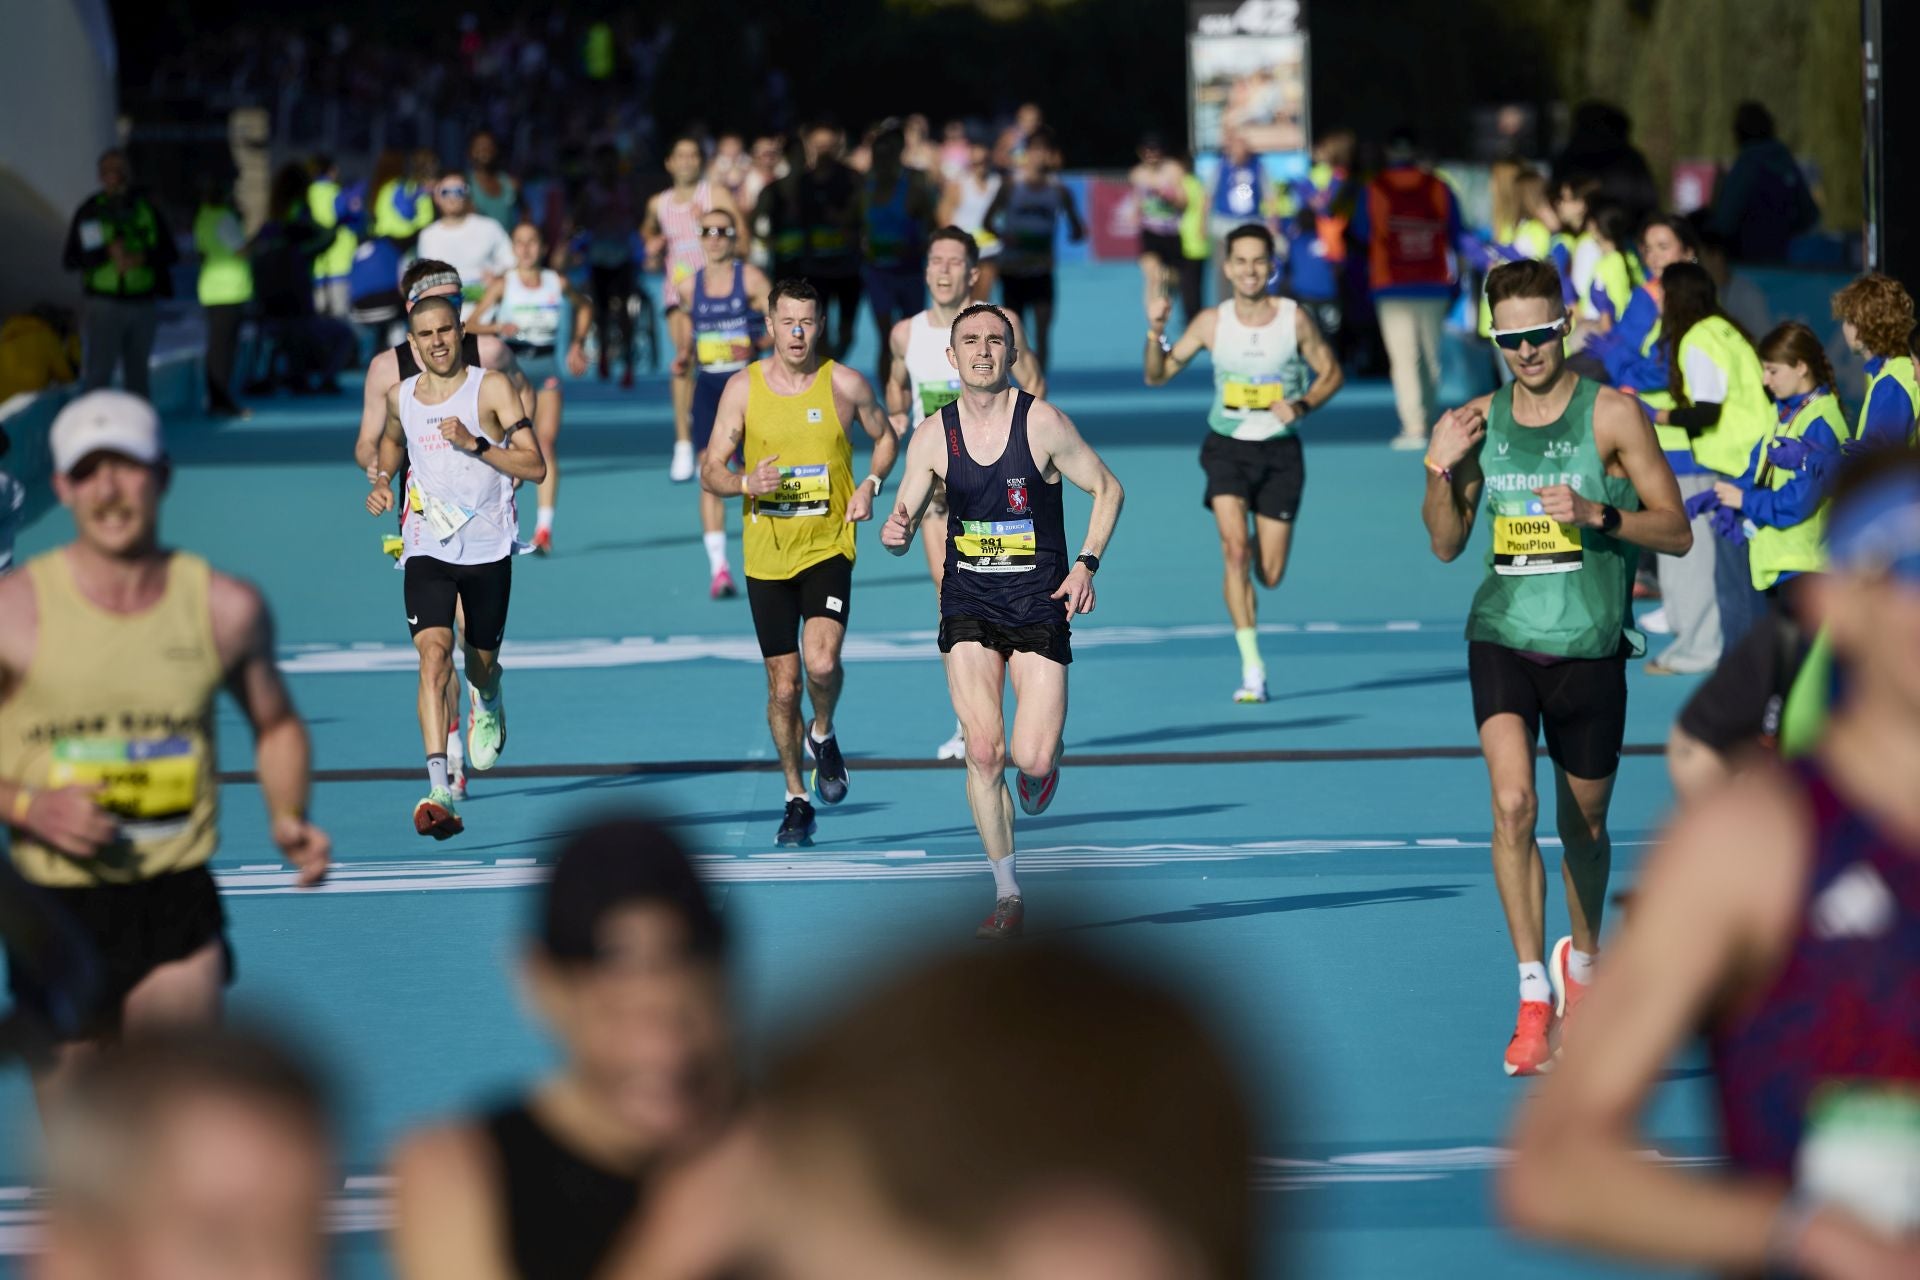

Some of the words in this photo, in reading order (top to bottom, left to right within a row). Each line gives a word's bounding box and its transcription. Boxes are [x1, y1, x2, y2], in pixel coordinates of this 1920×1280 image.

[424, 441, 450, 452] TEAM
[949, 426, 960, 458] soar
[1006, 477, 1026, 485] KENT
[1005, 523, 1025, 531] ZURICH
[1508, 520, 1551, 536] 10099
[1506, 539, 1556, 552] PlouPlou
